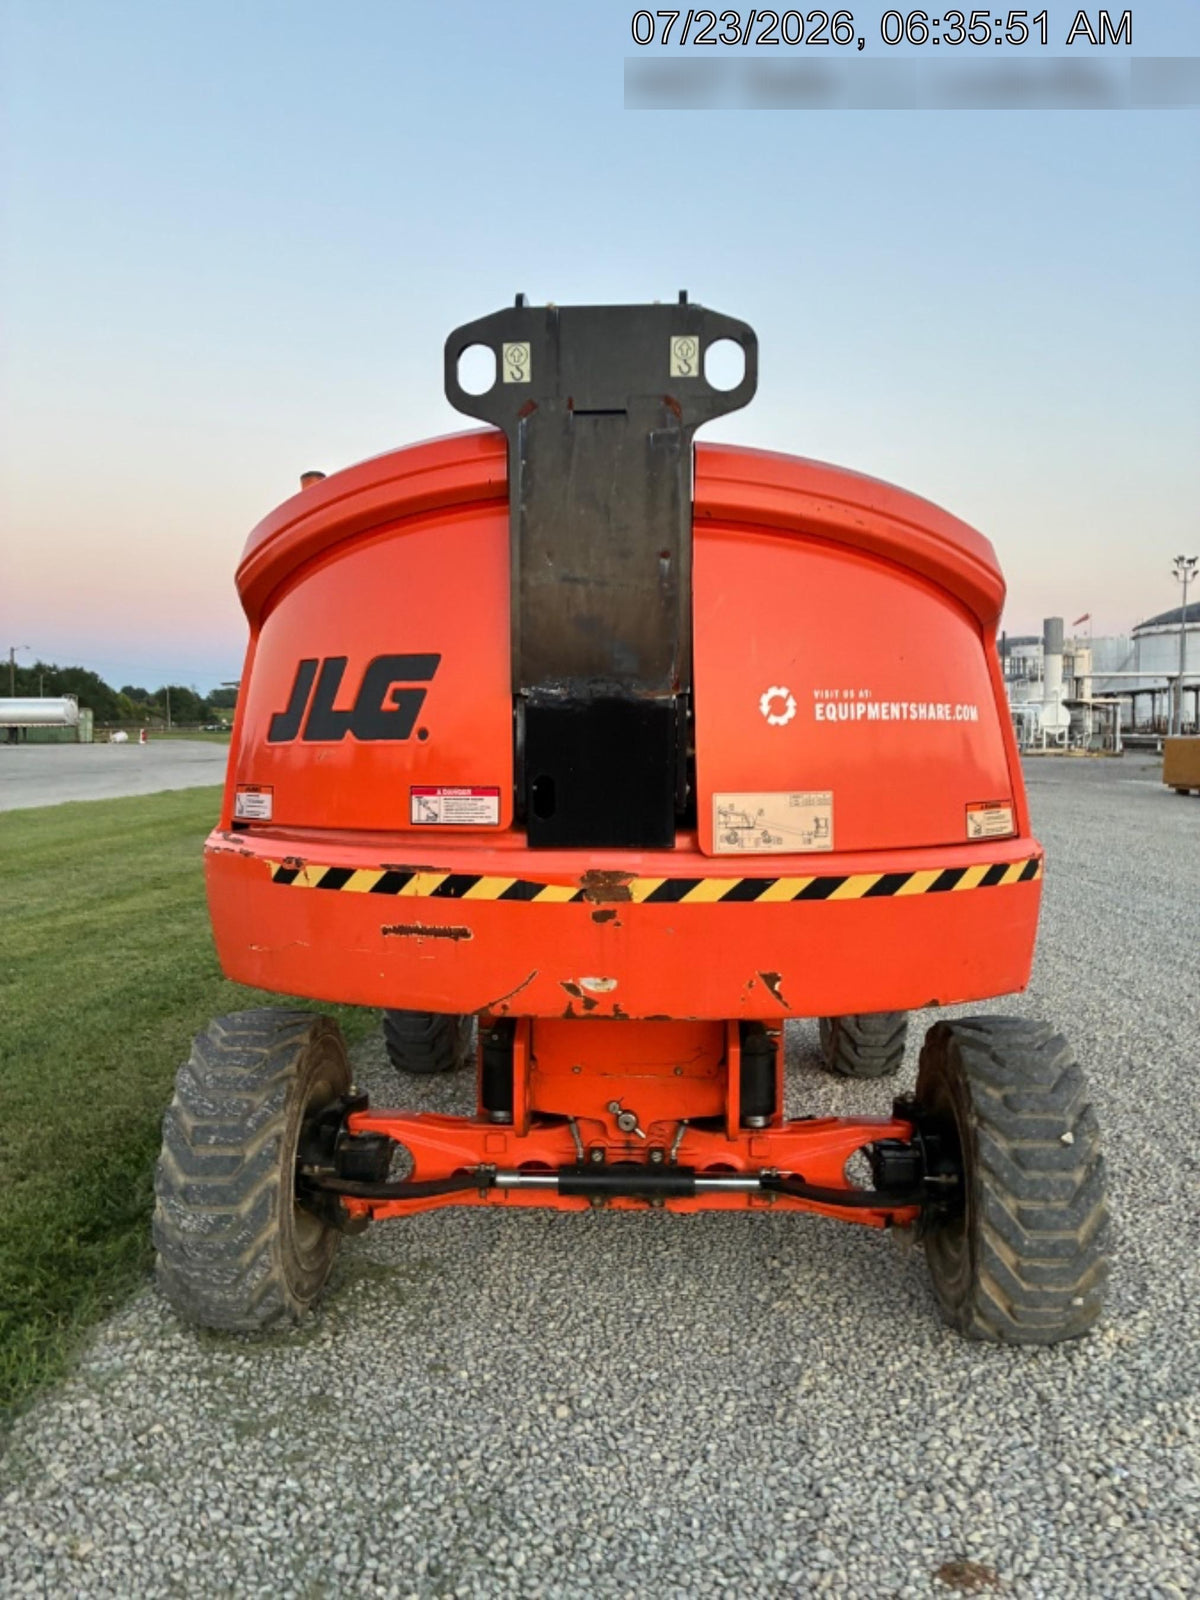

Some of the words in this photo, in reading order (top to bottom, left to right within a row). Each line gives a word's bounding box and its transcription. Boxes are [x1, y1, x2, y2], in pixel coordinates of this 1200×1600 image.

[813, 689, 839, 699] VISIT
[843, 689, 855, 699] US
[814, 702, 979, 723] EQUIPMENTSHARE.COM
